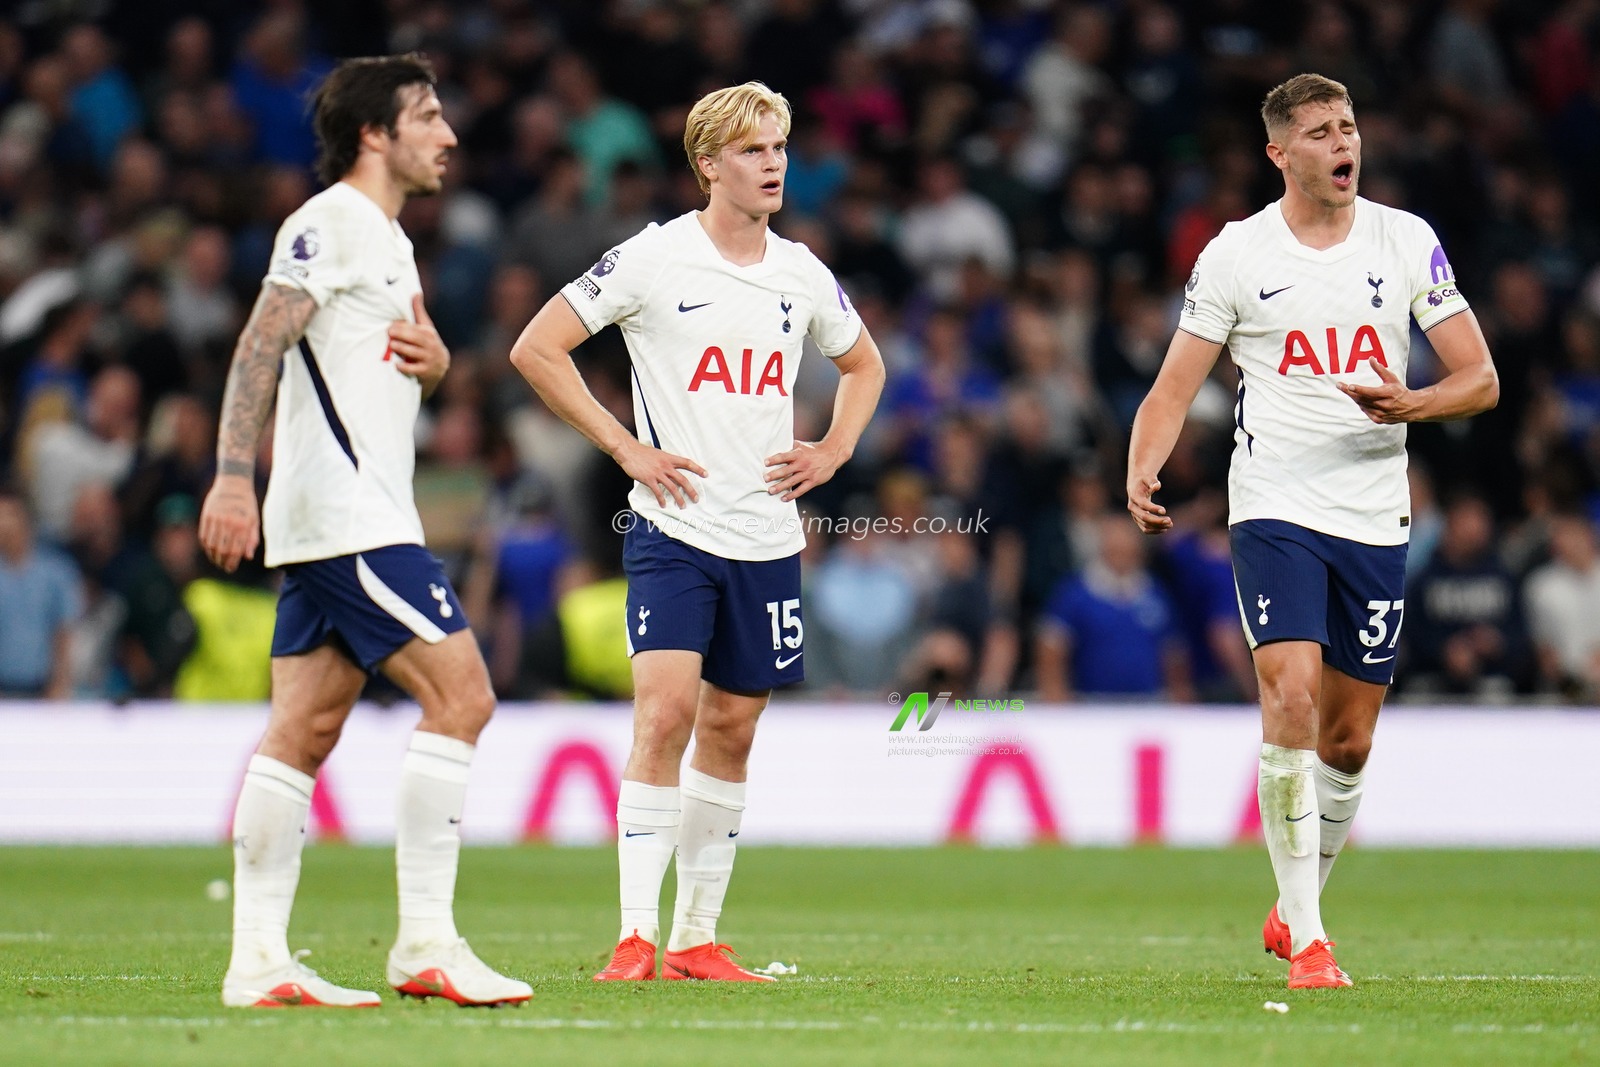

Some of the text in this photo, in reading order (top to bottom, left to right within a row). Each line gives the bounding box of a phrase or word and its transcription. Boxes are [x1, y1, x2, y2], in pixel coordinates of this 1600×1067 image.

[687, 346, 789, 397] AIA
[1278, 325, 1388, 376] AIA
[766, 598, 804, 650] 15
[1358, 598, 1404, 649] 37
